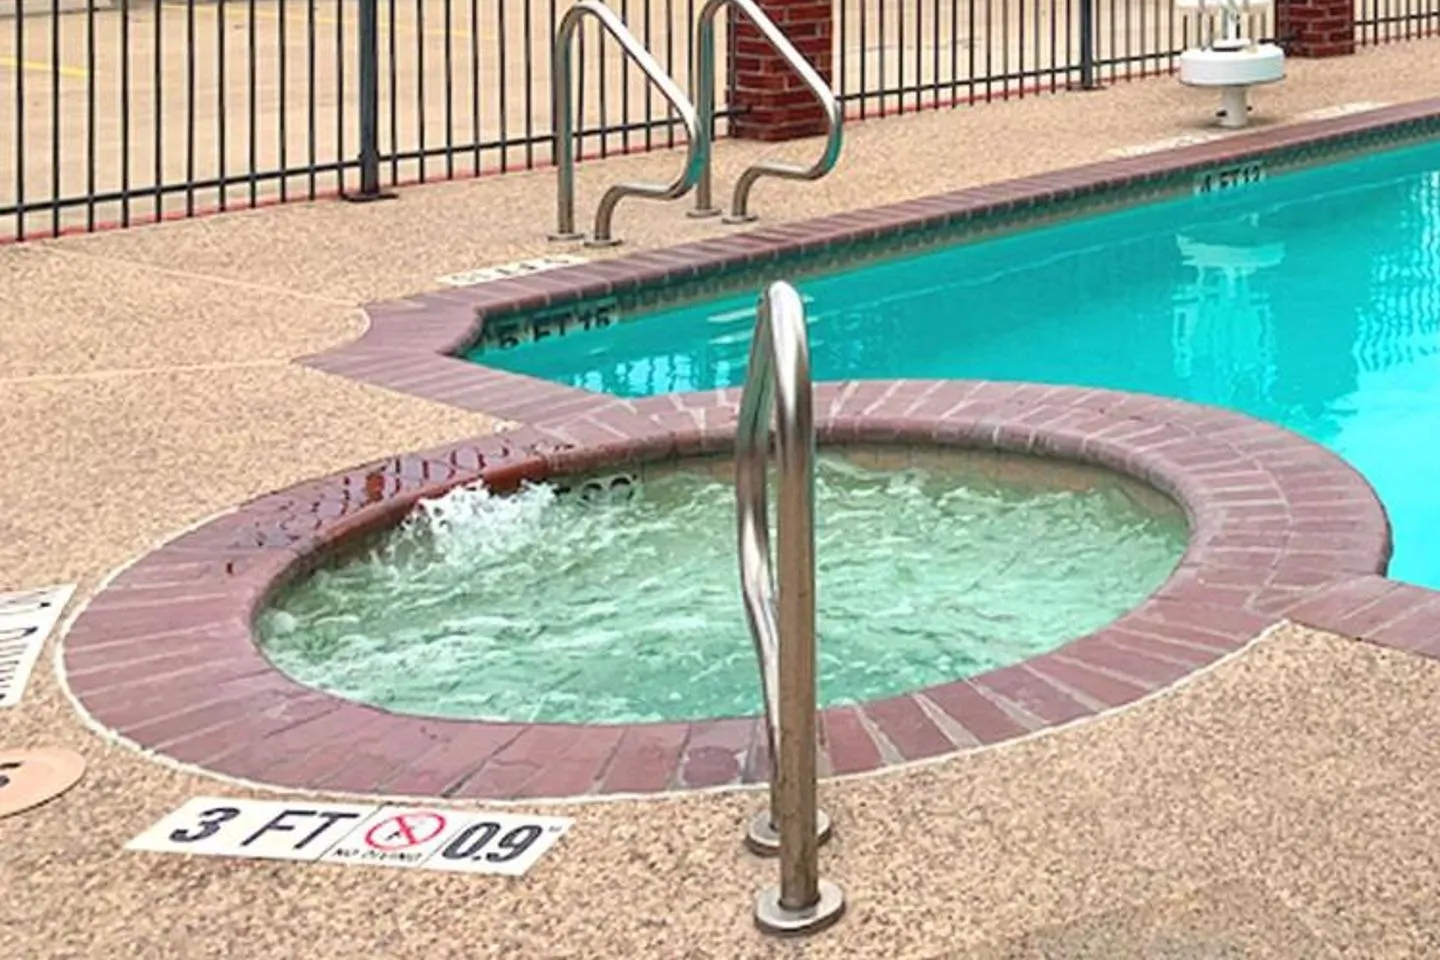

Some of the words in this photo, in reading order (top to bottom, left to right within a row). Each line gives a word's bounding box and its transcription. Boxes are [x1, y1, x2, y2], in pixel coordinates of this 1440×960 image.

[168, 806, 241, 843] 3
[240, 809, 361, 851] FT
[441, 821, 544, 863] 0.9
